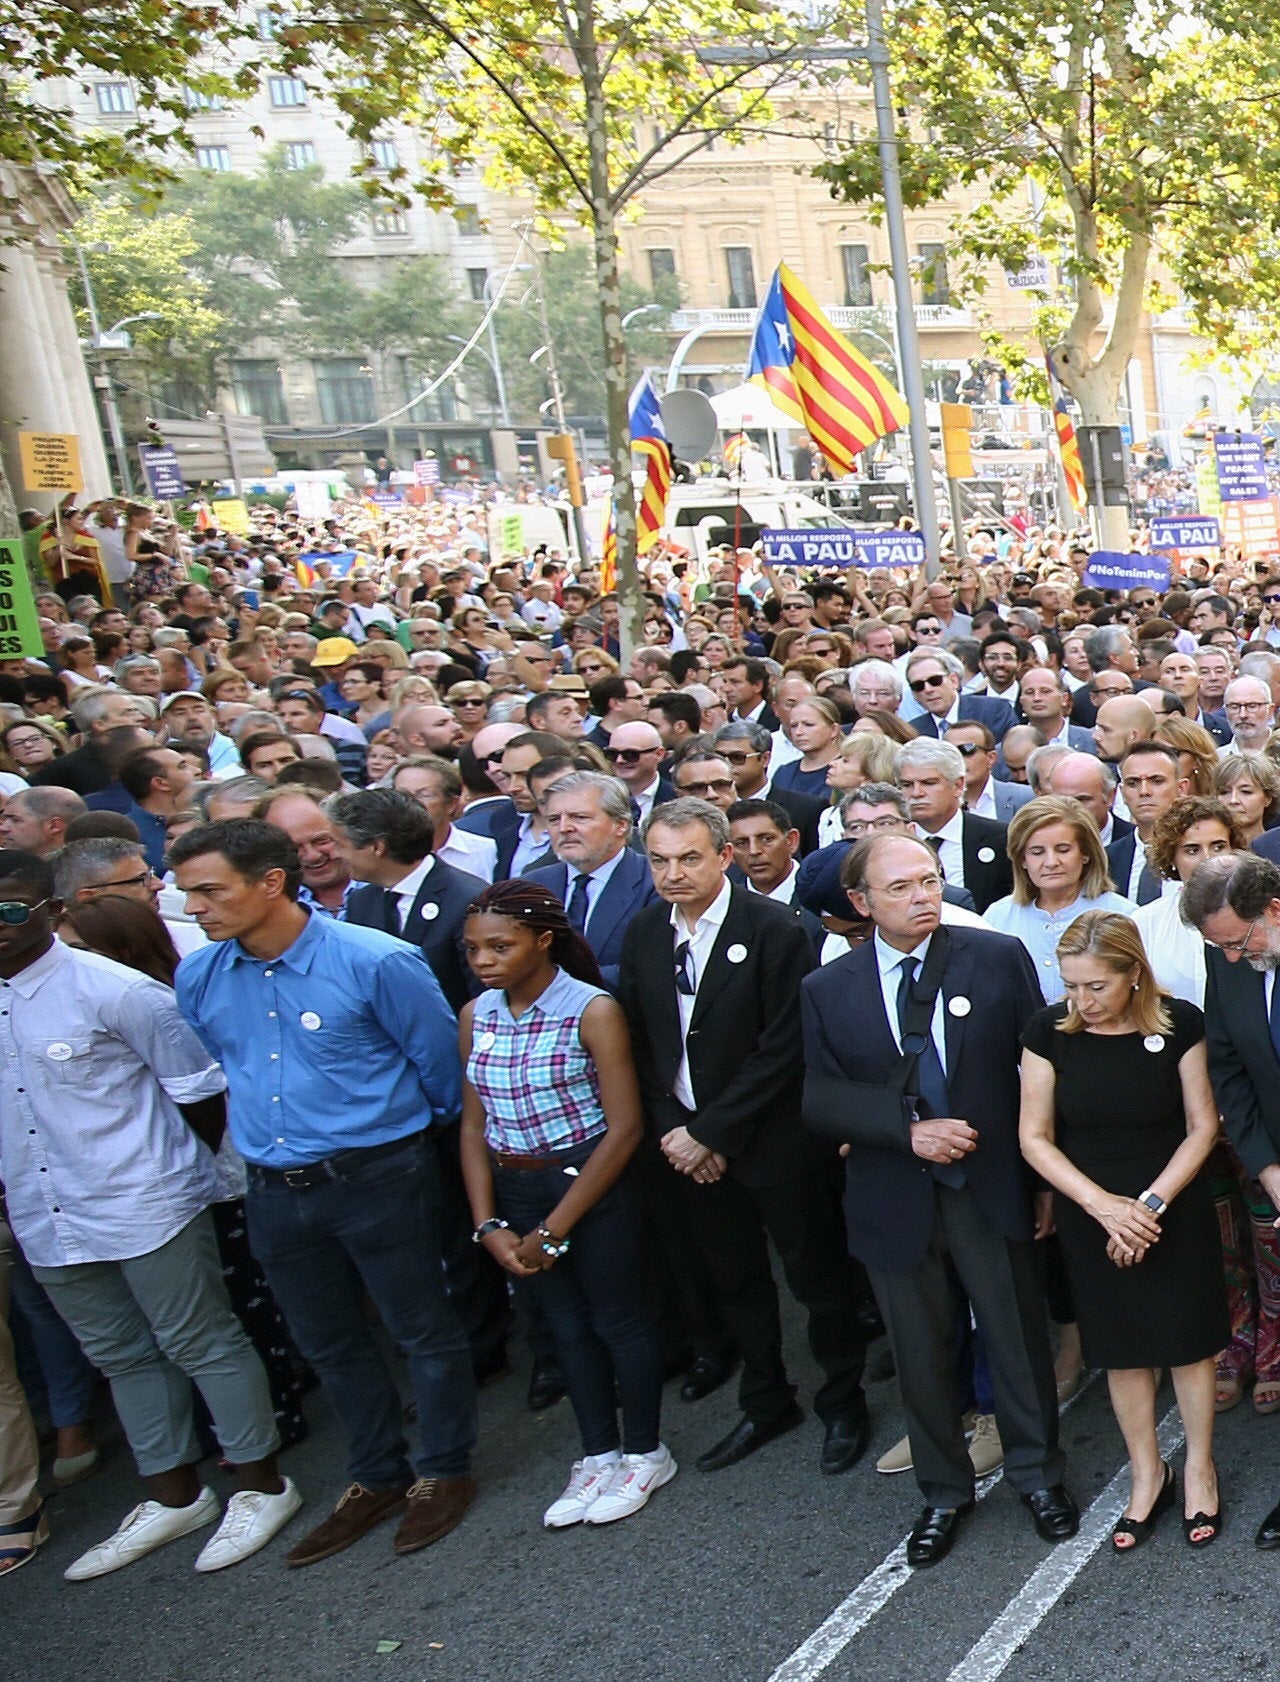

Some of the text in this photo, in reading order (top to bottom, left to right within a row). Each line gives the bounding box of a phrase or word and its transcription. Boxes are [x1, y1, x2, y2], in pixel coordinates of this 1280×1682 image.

[775, 534, 808, 543] MILLOR
[809, 533, 852, 542] RESPOSTA
[882, 536, 923, 545] RESPOSTA
[1152, 528, 1218, 546] LA PAU
[764, 542, 853, 562] LA PAU
[875, 544, 925, 563] PAU
[1088, 563, 1168, 581] #NoTenimPor
